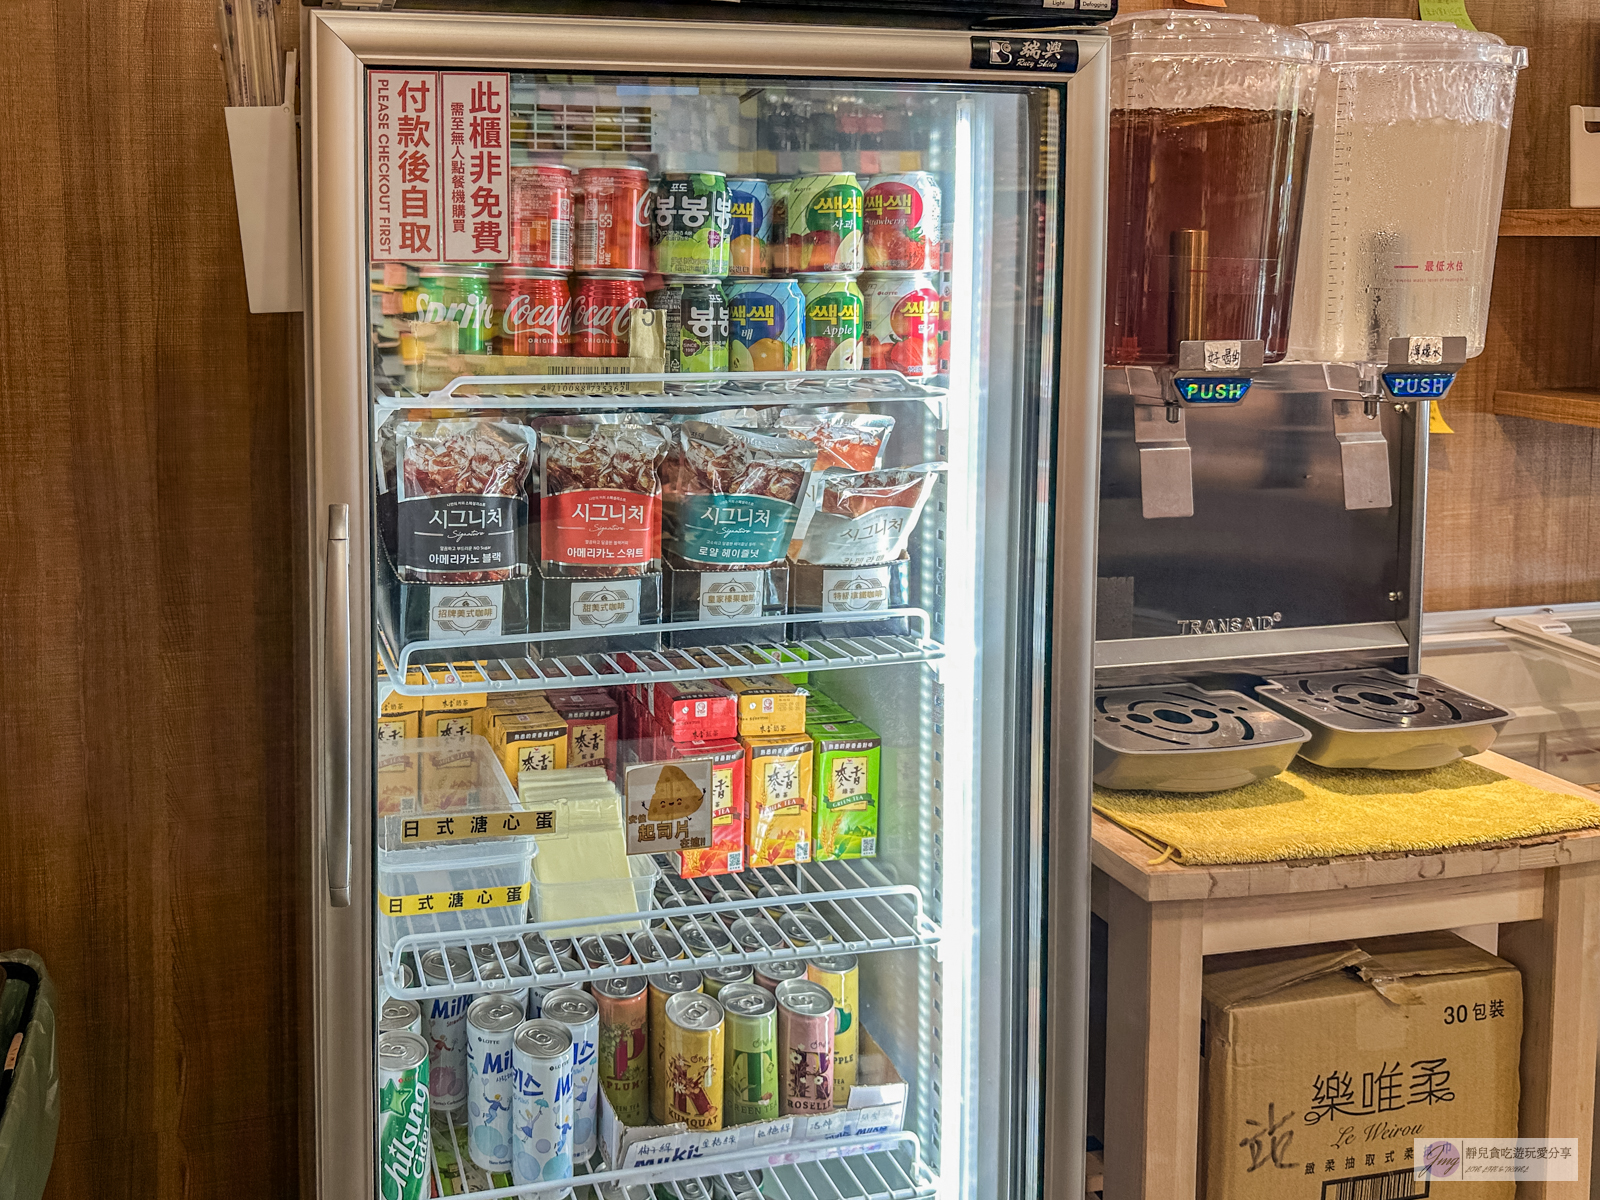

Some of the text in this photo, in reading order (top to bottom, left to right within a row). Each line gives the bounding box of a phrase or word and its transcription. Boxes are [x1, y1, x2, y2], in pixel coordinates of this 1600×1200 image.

[1019, 40, 1064, 60] 瑞興
[377, 79, 391, 254] PLEASE CHECKOUT FIRST
[397, 80, 432, 254] 付款後自取
[451, 102, 466, 233] 需至無人點餐機購買
[469, 81, 502, 254] 此櫃非免費
[670, 183, 688, 192] 포도
[655, 195, 710, 228] 봉봉
[865, 194, 912, 216] 쌕쌕
[832, 219, 854, 230] 사과
[605, 252, 612, 265] ME
[1424, 260, 1463, 272] 最低水位
[728, 304, 774, 326] 쌕쌕
[528, 337, 562, 345] ORIGINAL
[584, 337, 620, 345] ORIGINAL
[741, 328, 754, 340] 배
[822, 325, 853, 337] Apple
[1186, 383, 1242, 399] PUSH
[1393, 378, 1444, 394] PUSH
[428, 507, 502, 529] 시그니처
[571, 503, 644, 524] 시그니처
[700, 506, 771, 528] 시그니처
[840, 517, 904, 541] 시그니처
[428, 552, 501, 565] 아메리카노 블랙
[567, 547, 644, 559] 아메리카노 스위트
[698, 546, 759, 559] 로얄 헤이즐넛
[438, 608, 493, 619] 招牌美式咖啡
[582, 602, 626, 613] 甜美式咖啡
[1177, 615, 1274, 636] TRANSAID
[380, 702, 404, 711] 香奶茶
[574, 730, 604, 755] 麥香
[767, 765, 798, 794] 麥香
[835, 761, 866, 789] 麥香
[784, 799, 797, 808] TEA
[832, 795, 864, 808] GREEN TEA
[404, 811, 553, 838] 日式溏心蛋
[637, 820, 689, 842] 起司片
[389, 885, 522, 914] 日式溏心蛋
[1443, 998, 1505, 1025] 30包裝
[606, 1080, 640, 1091] PLUM
[1304, 1057, 1455, 1126] 樂唯柔
[727, 1100, 778, 1115] GREEN TEA
[787, 1100, 831, 1111] ROSELLE
[668, 1107, 718, 1128] KUMQUAT
[1330, 1121, 1425, 1149] Le Weirou
[413, 1114, 430, 1179] Cider
